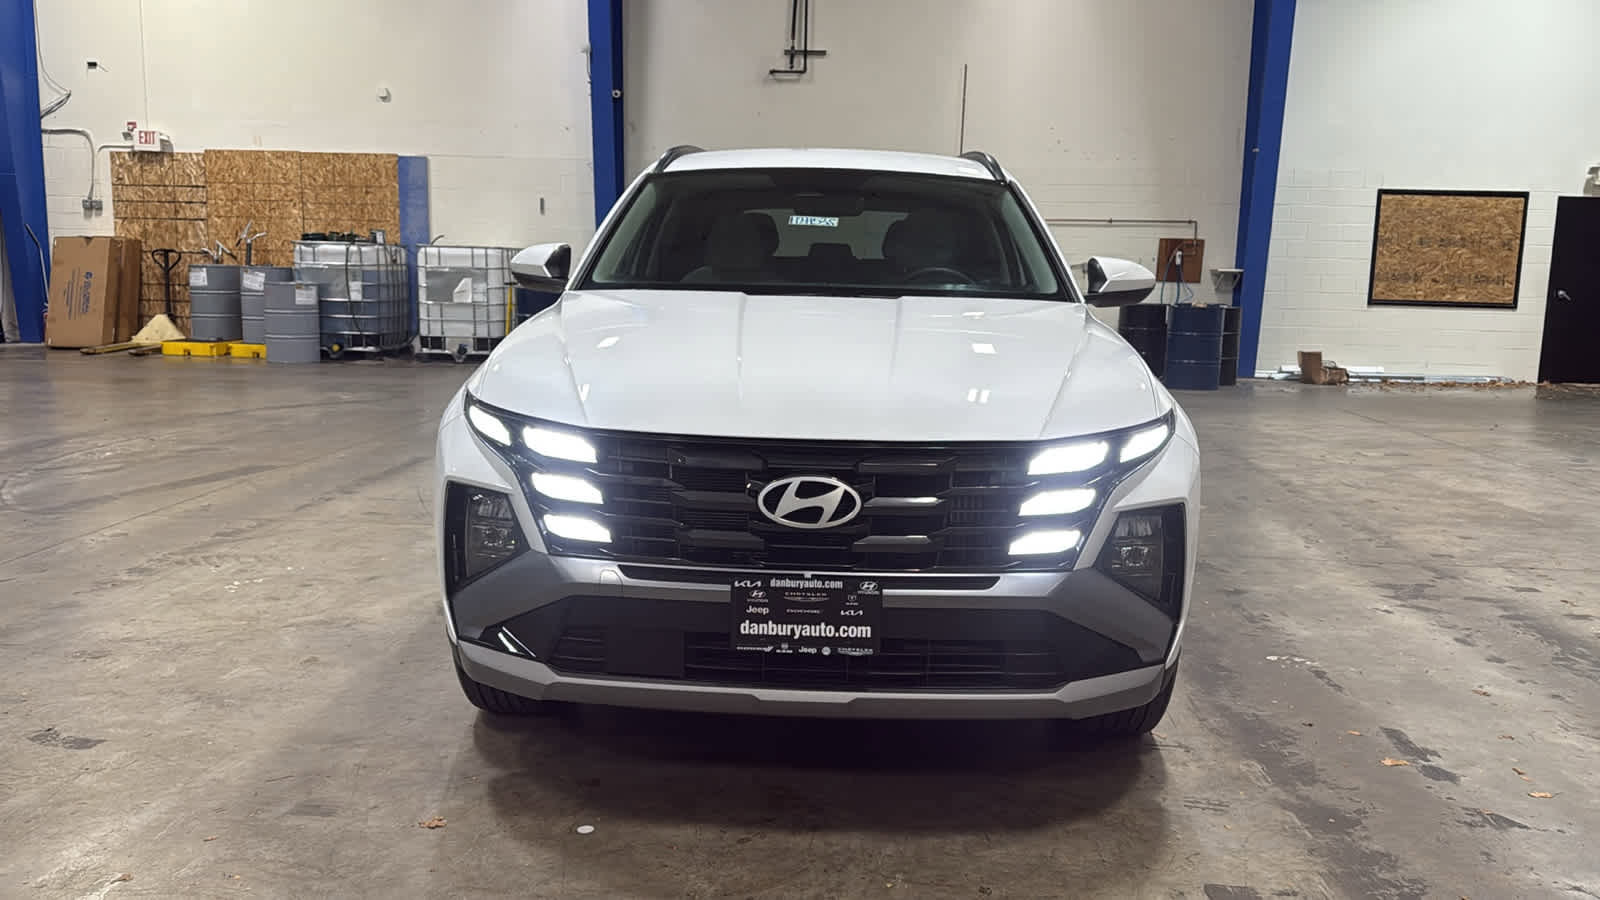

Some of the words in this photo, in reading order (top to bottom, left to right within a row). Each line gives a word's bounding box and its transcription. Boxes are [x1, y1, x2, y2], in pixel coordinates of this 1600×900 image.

[138, 131, 155, 144] EXIT
[770, 578, 843, 589] danburyauto.com
[746, 605, 770, 615] Jeep
[740, 620, 872, 639] danburyauto.com
[798, 646, 817, 654] Jeep
